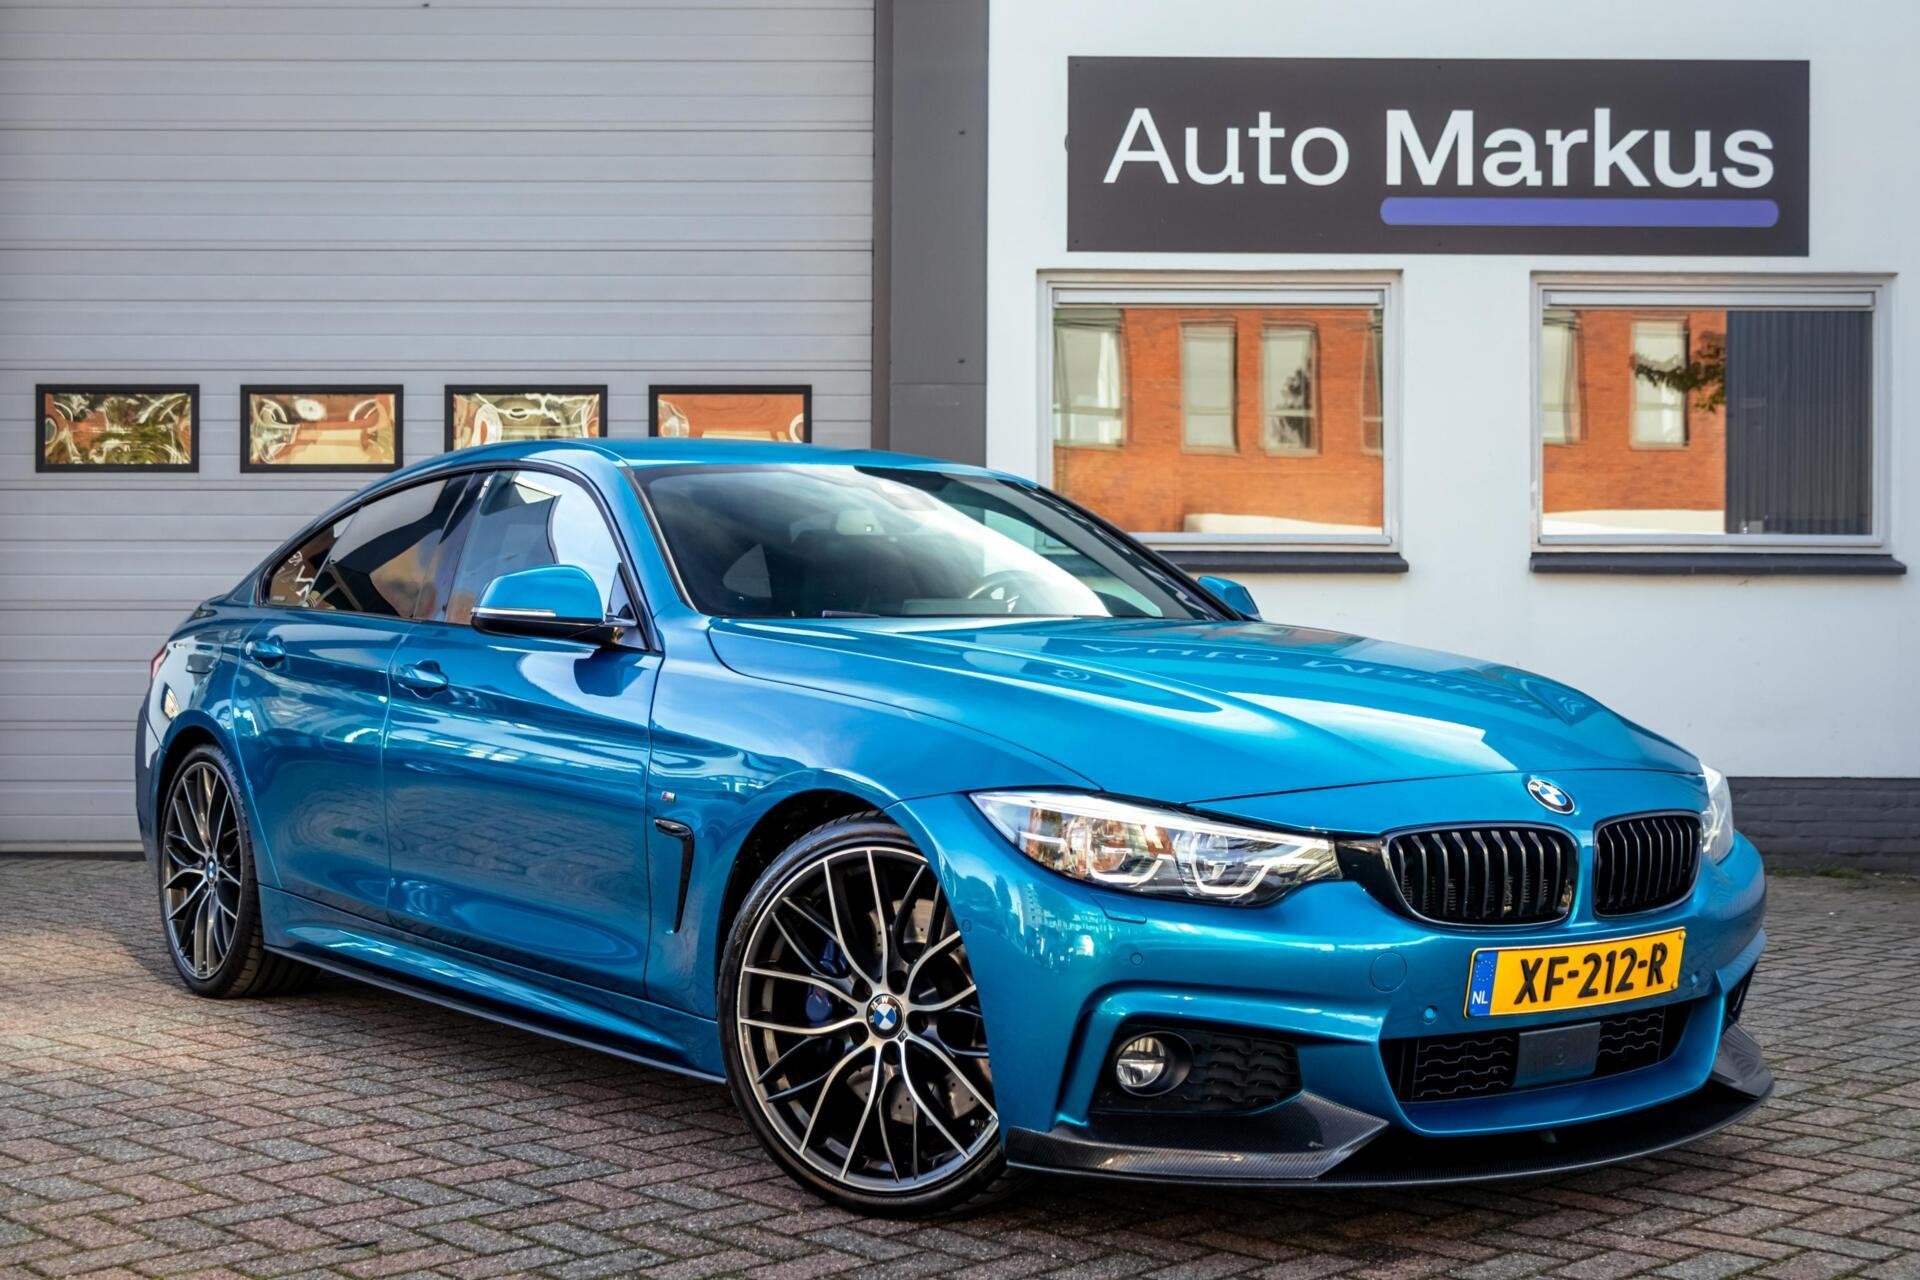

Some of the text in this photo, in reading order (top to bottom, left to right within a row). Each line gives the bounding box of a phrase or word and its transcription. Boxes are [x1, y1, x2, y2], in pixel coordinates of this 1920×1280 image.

[1103, 107, 1775, 189] Auto Markus
[1471, 990, 1489, 1005] NL
[1513, 942, 1668, 1005] XF-212-R
